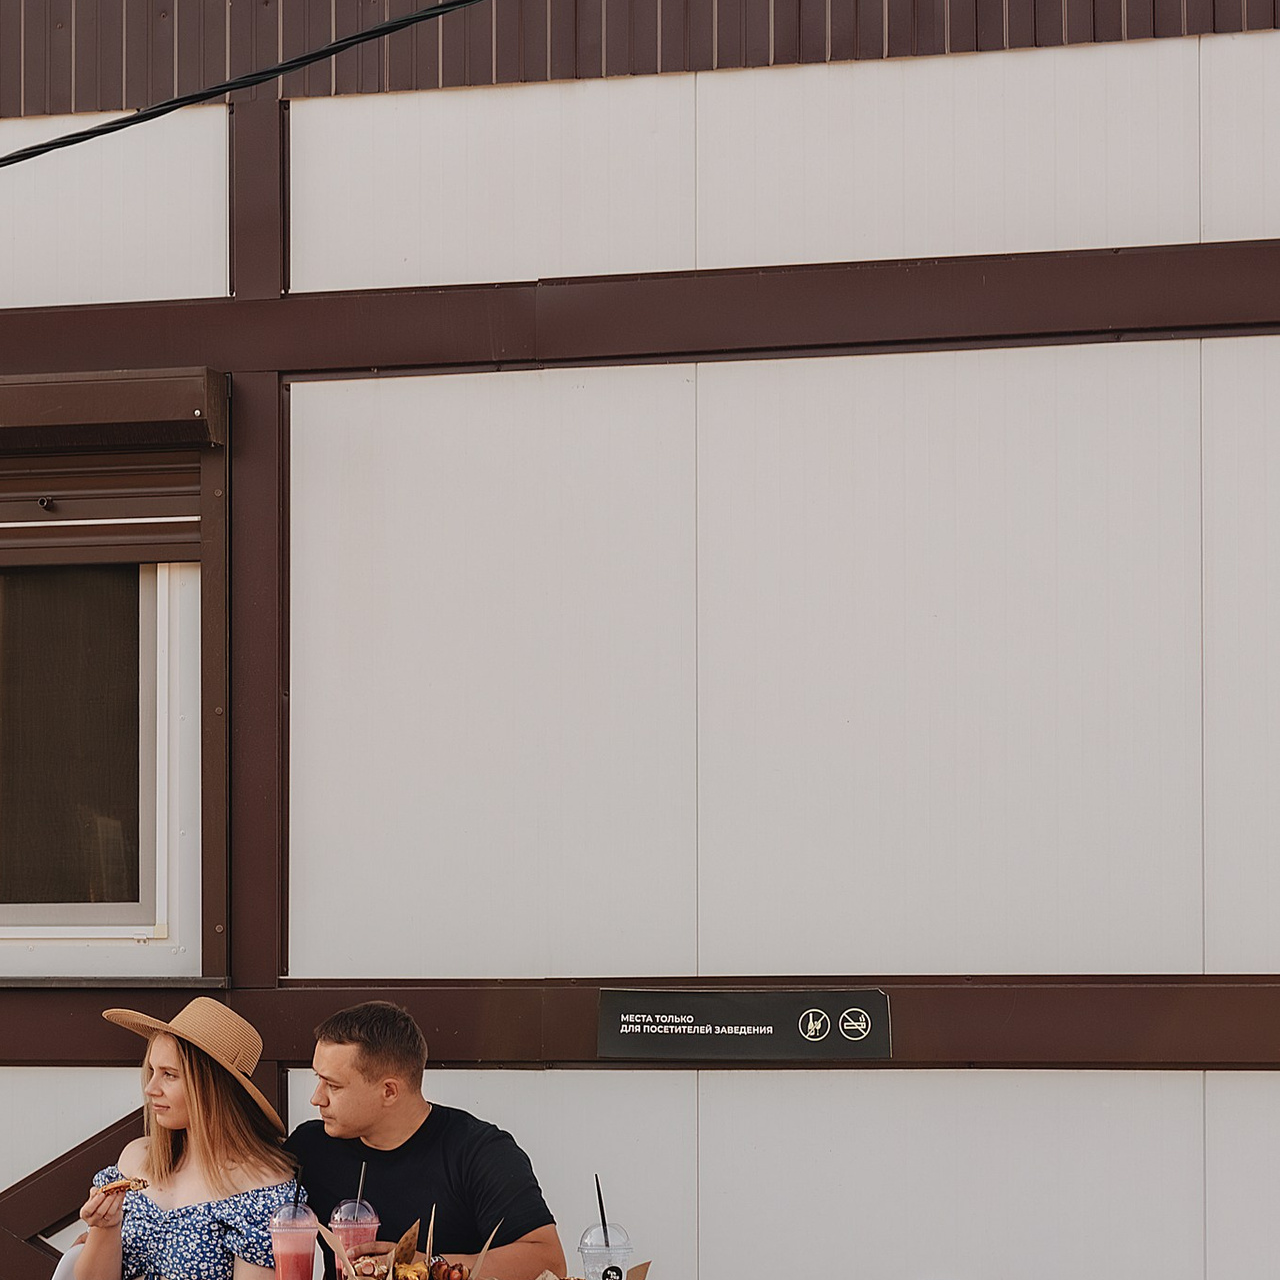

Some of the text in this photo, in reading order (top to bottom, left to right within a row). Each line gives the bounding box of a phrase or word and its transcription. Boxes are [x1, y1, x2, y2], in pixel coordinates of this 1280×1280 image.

[620, 1013, 695, 1024] МЕСТА ТОЛЬКО
[620, 1023, 773, 1036] ДЛЯ ПОСЕТИТЕЛЕЙ ЗАВЕДЕНИЯ
